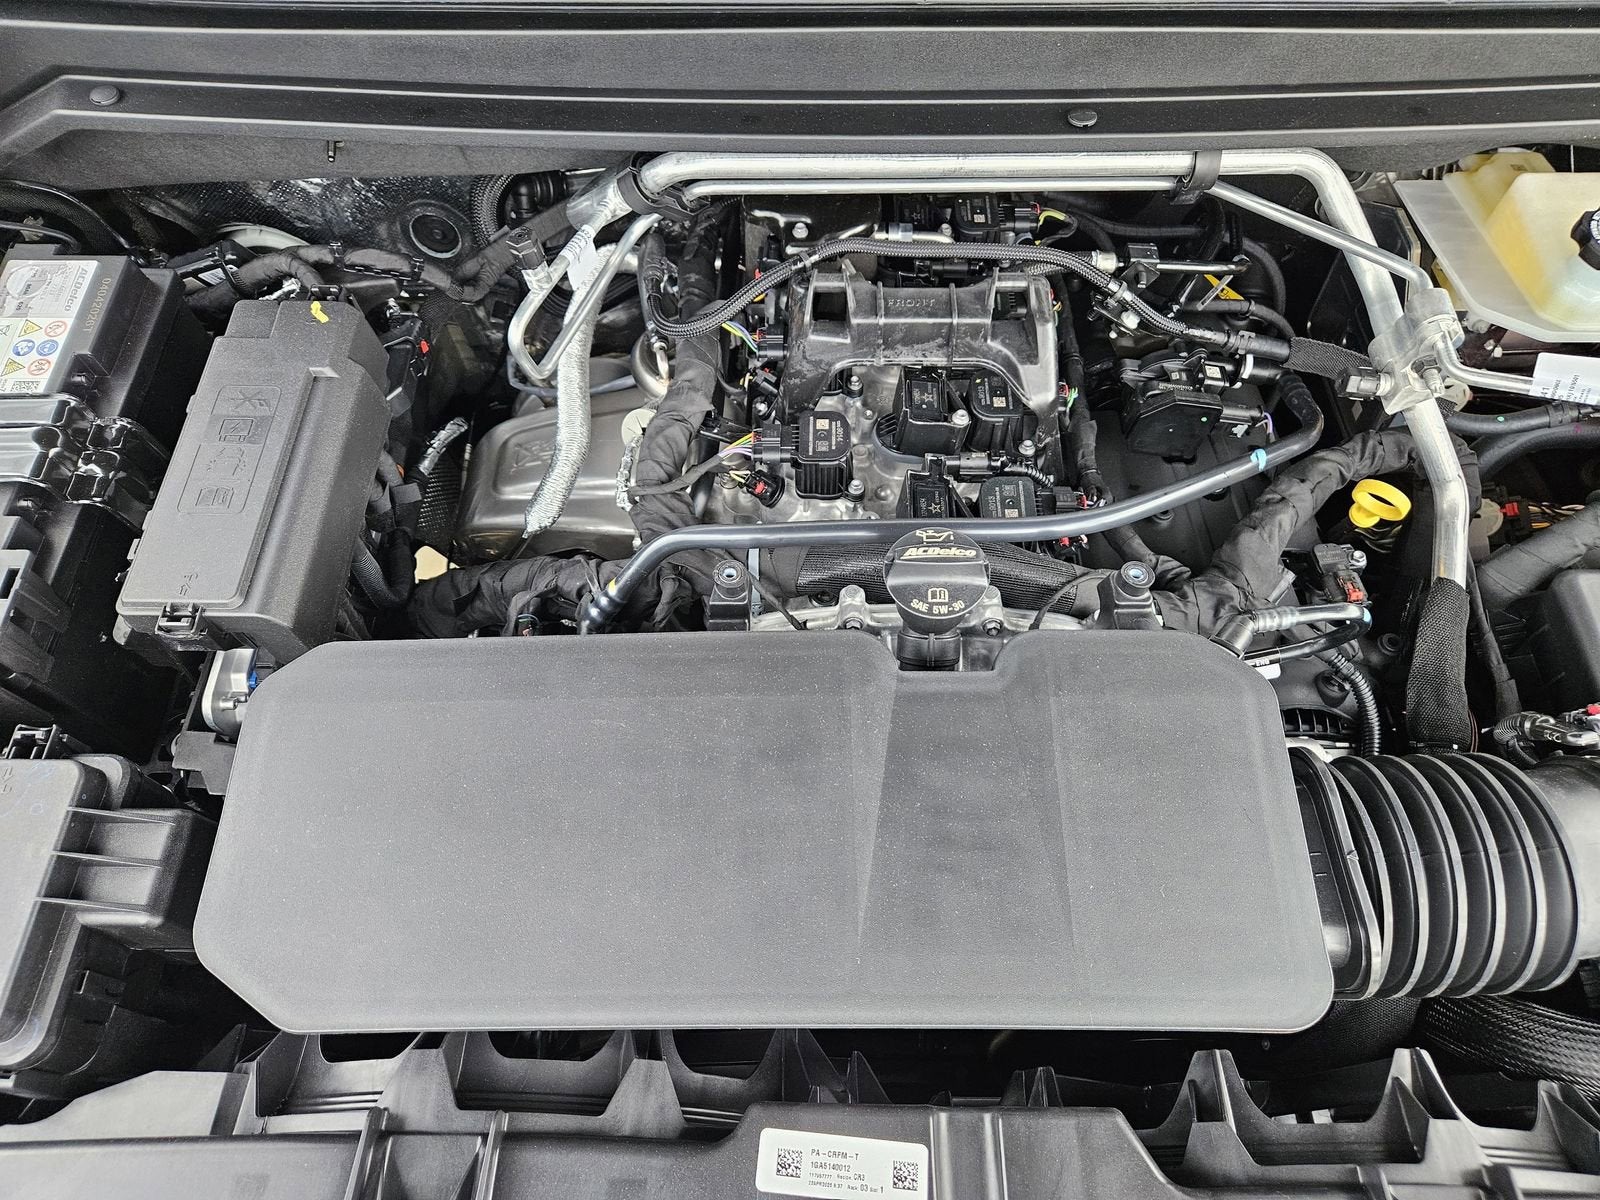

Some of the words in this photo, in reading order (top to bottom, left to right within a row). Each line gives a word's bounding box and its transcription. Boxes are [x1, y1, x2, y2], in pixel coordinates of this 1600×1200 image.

[64, 265, 88, 312] ACDelco
[903, 547, 977, 557] ACDelco
[911, 598, 930, 613] SAE
[932, 600, 965, 615] 5W-30
[860, 1183, 869, 1192] 03
